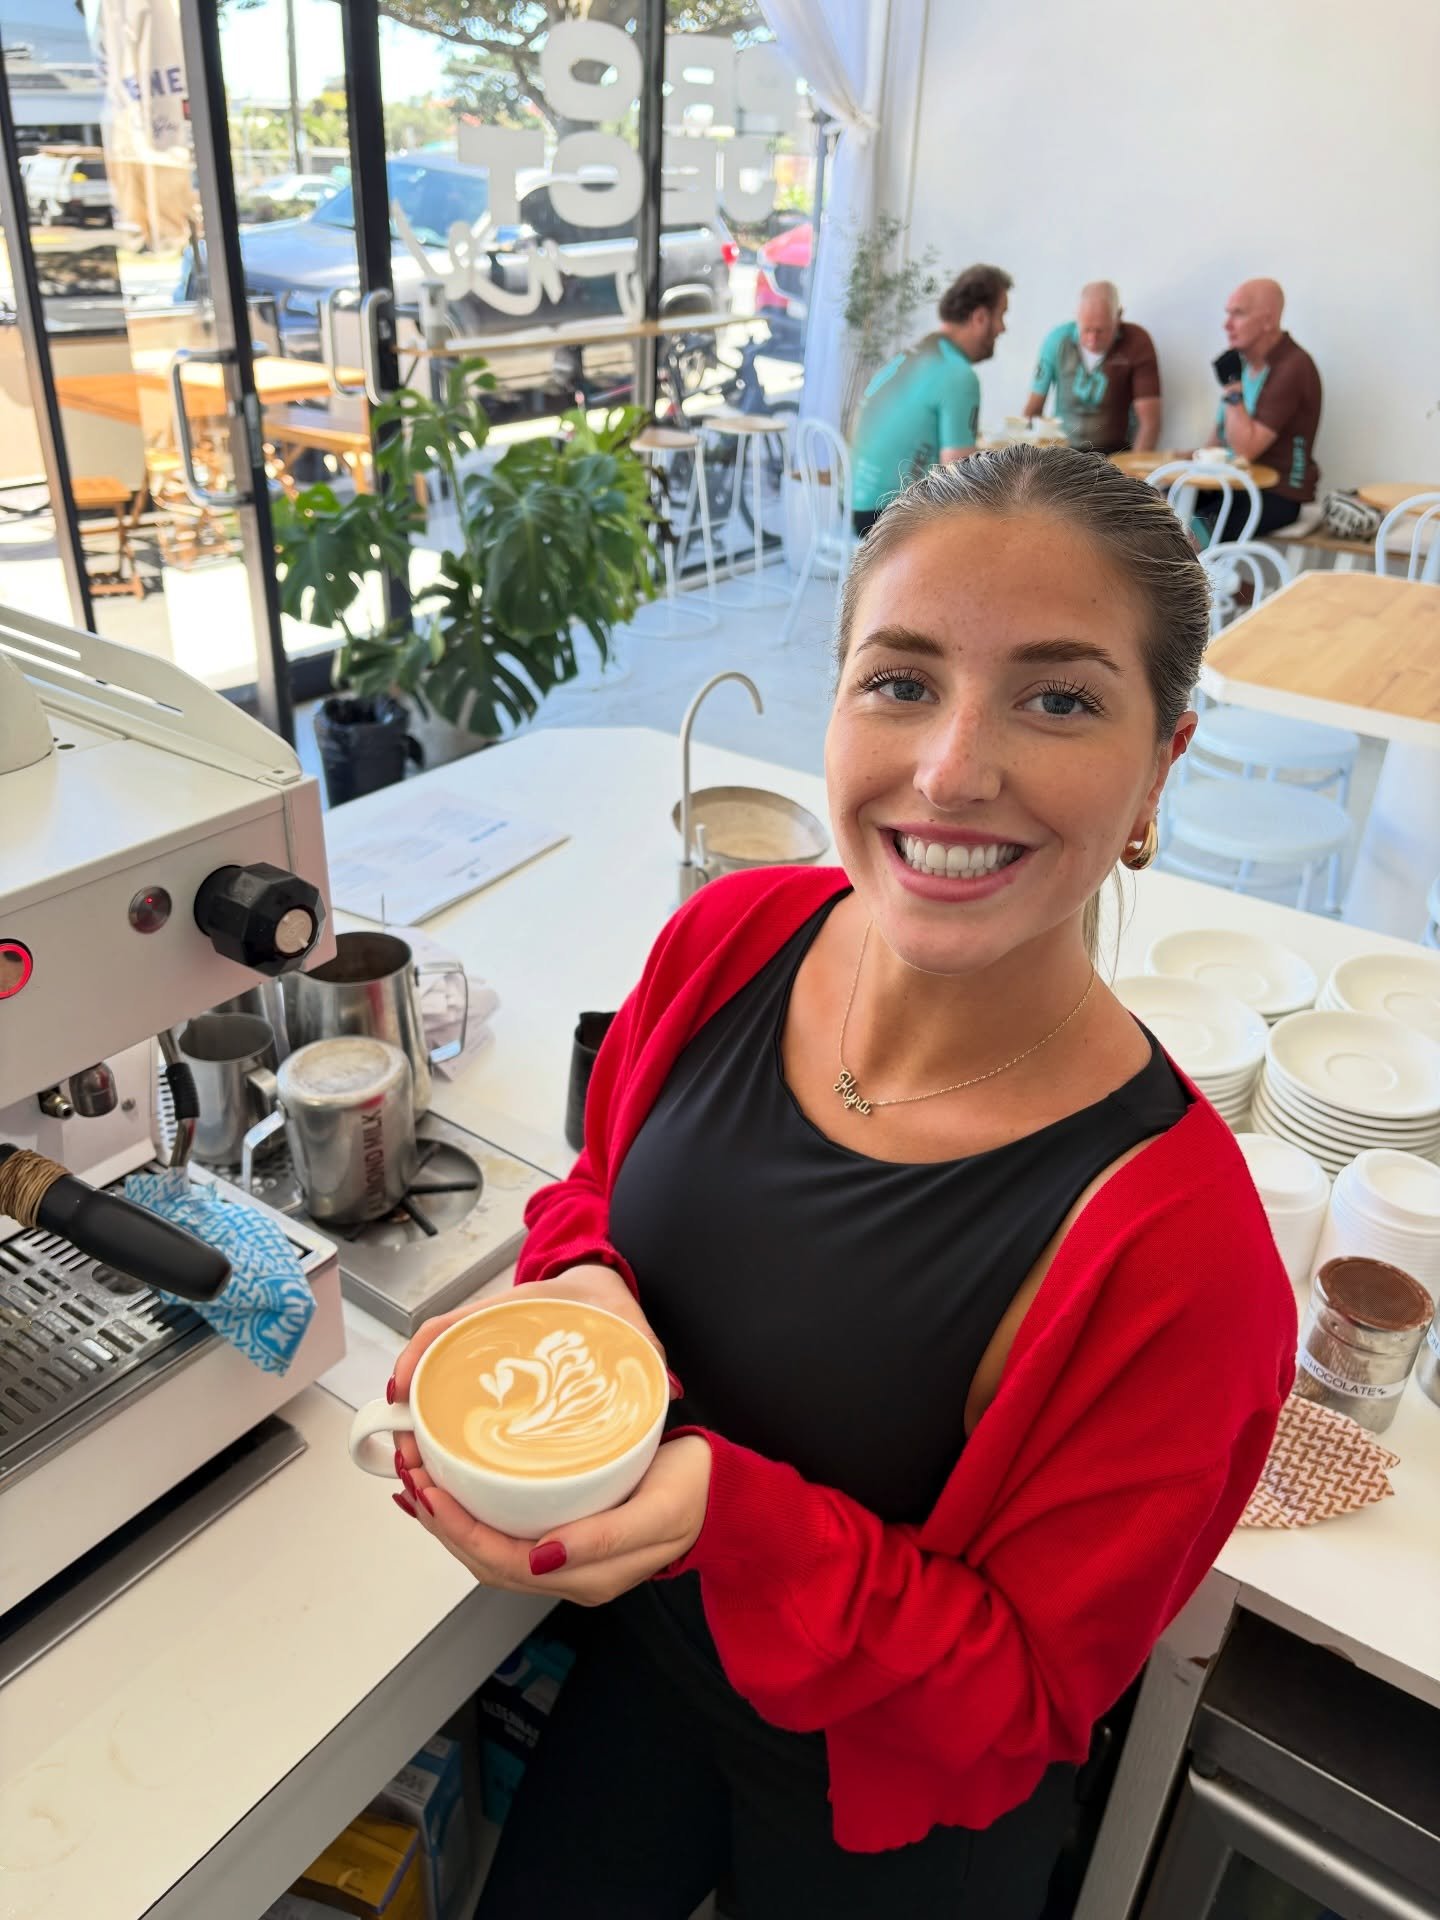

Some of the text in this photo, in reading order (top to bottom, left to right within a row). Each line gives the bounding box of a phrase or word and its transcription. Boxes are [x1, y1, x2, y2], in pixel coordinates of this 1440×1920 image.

[833, 1070, 871, 1115] Kyra
[362, 1110, 384, 1212] ALMOND MILK
[1304, 1355, 1376, 1396] CHOCOLATE
